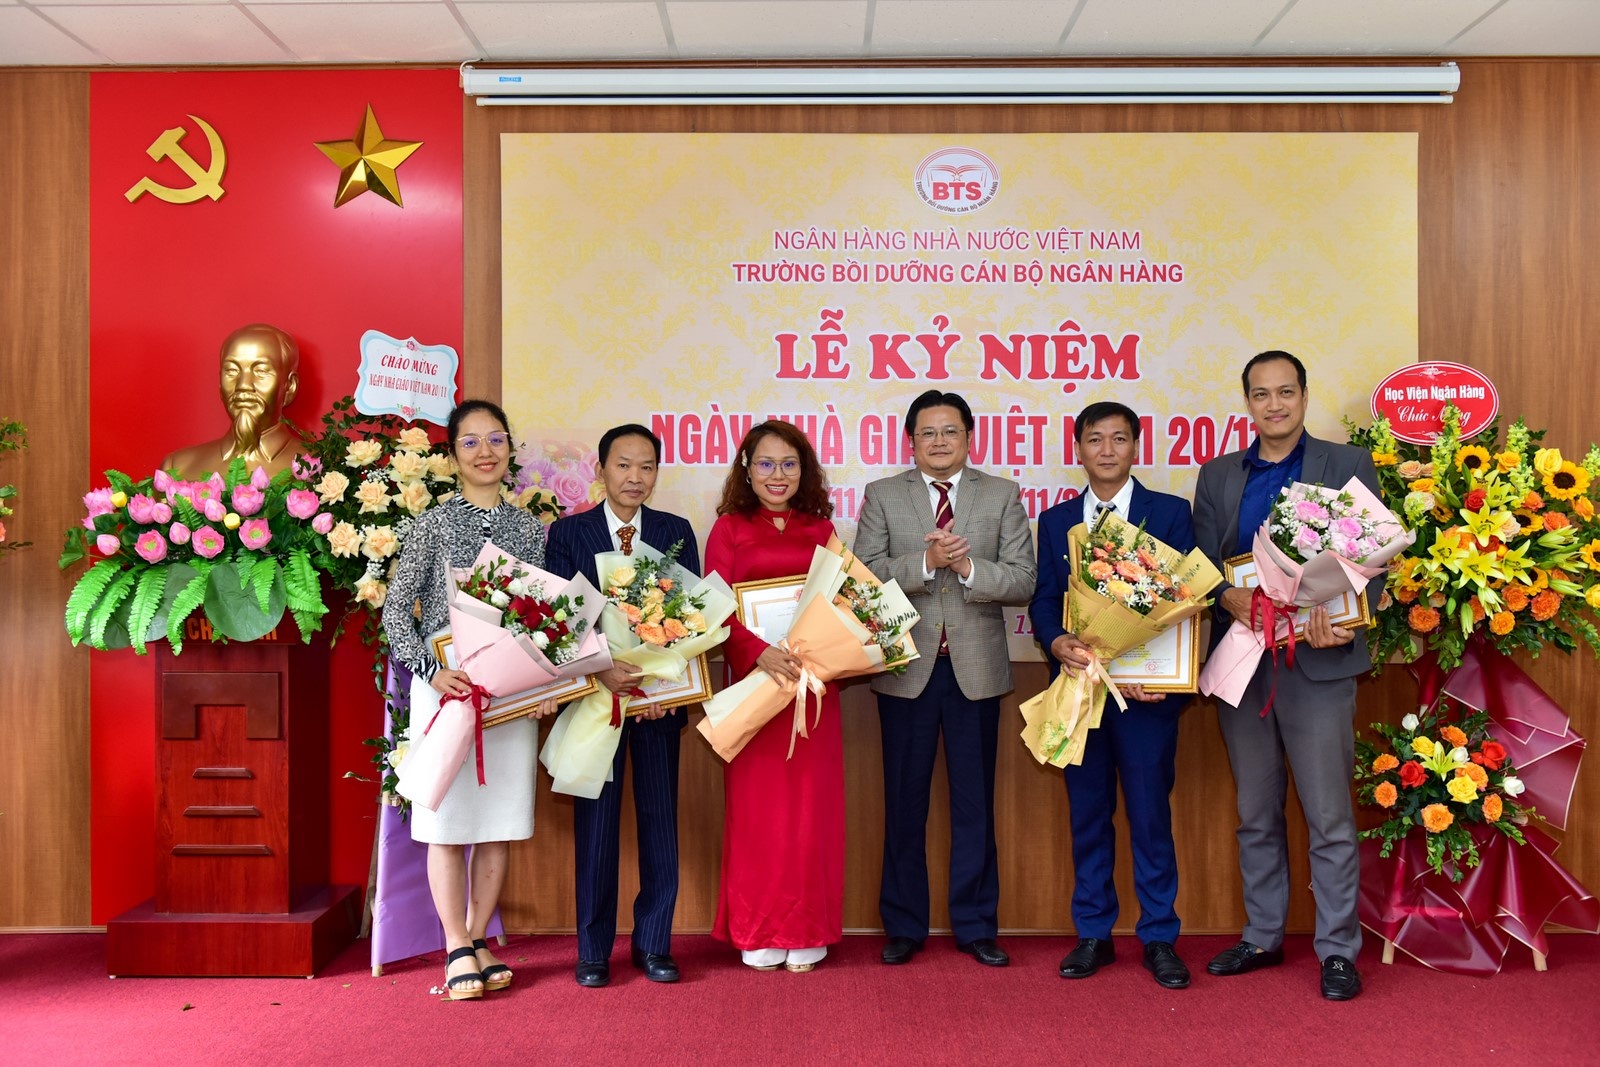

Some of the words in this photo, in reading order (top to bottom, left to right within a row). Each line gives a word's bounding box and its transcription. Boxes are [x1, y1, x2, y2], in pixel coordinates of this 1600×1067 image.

[933, 181, 982, 201] BTS
[774, 226, 836, 250] NGÂN
[845, 227, 906, 251] HÀNG
[913, 227, 959, 250] NHÀ
[967, 227, 1029, 251] NƯỚC
[1036, 227, 1083, 255] VIỆT
[1089, 231, 1141, 251] NAM
[733, 261, 825, 284] TRƯỜNG
[833, 261, 868, 284] BỒI
[876, 262, 954, 284] DƯỠNG
[960, 264, 1006, 284] CÁN
[1014, 262, 1039, 288] BỘ
[1050, 261, 1113, 284] NGÂN
[1121, 262, 1183, 284] HÀNG
[775, 308, 850, 380] LỄ
[869, 315, 961, 380] KỶ
[980, 319, 1141, 394] NIỆM
[1384, 387, 1404, 403] Học
[1406, 386, 1428, 403] Viện
[1431, 386, 1457, 400] Ngân
[1459, 385, 1486, 400] Hàng
[1397, 405, 1429, 423] Chúc
[767, 405, 844, 464] HÀ
